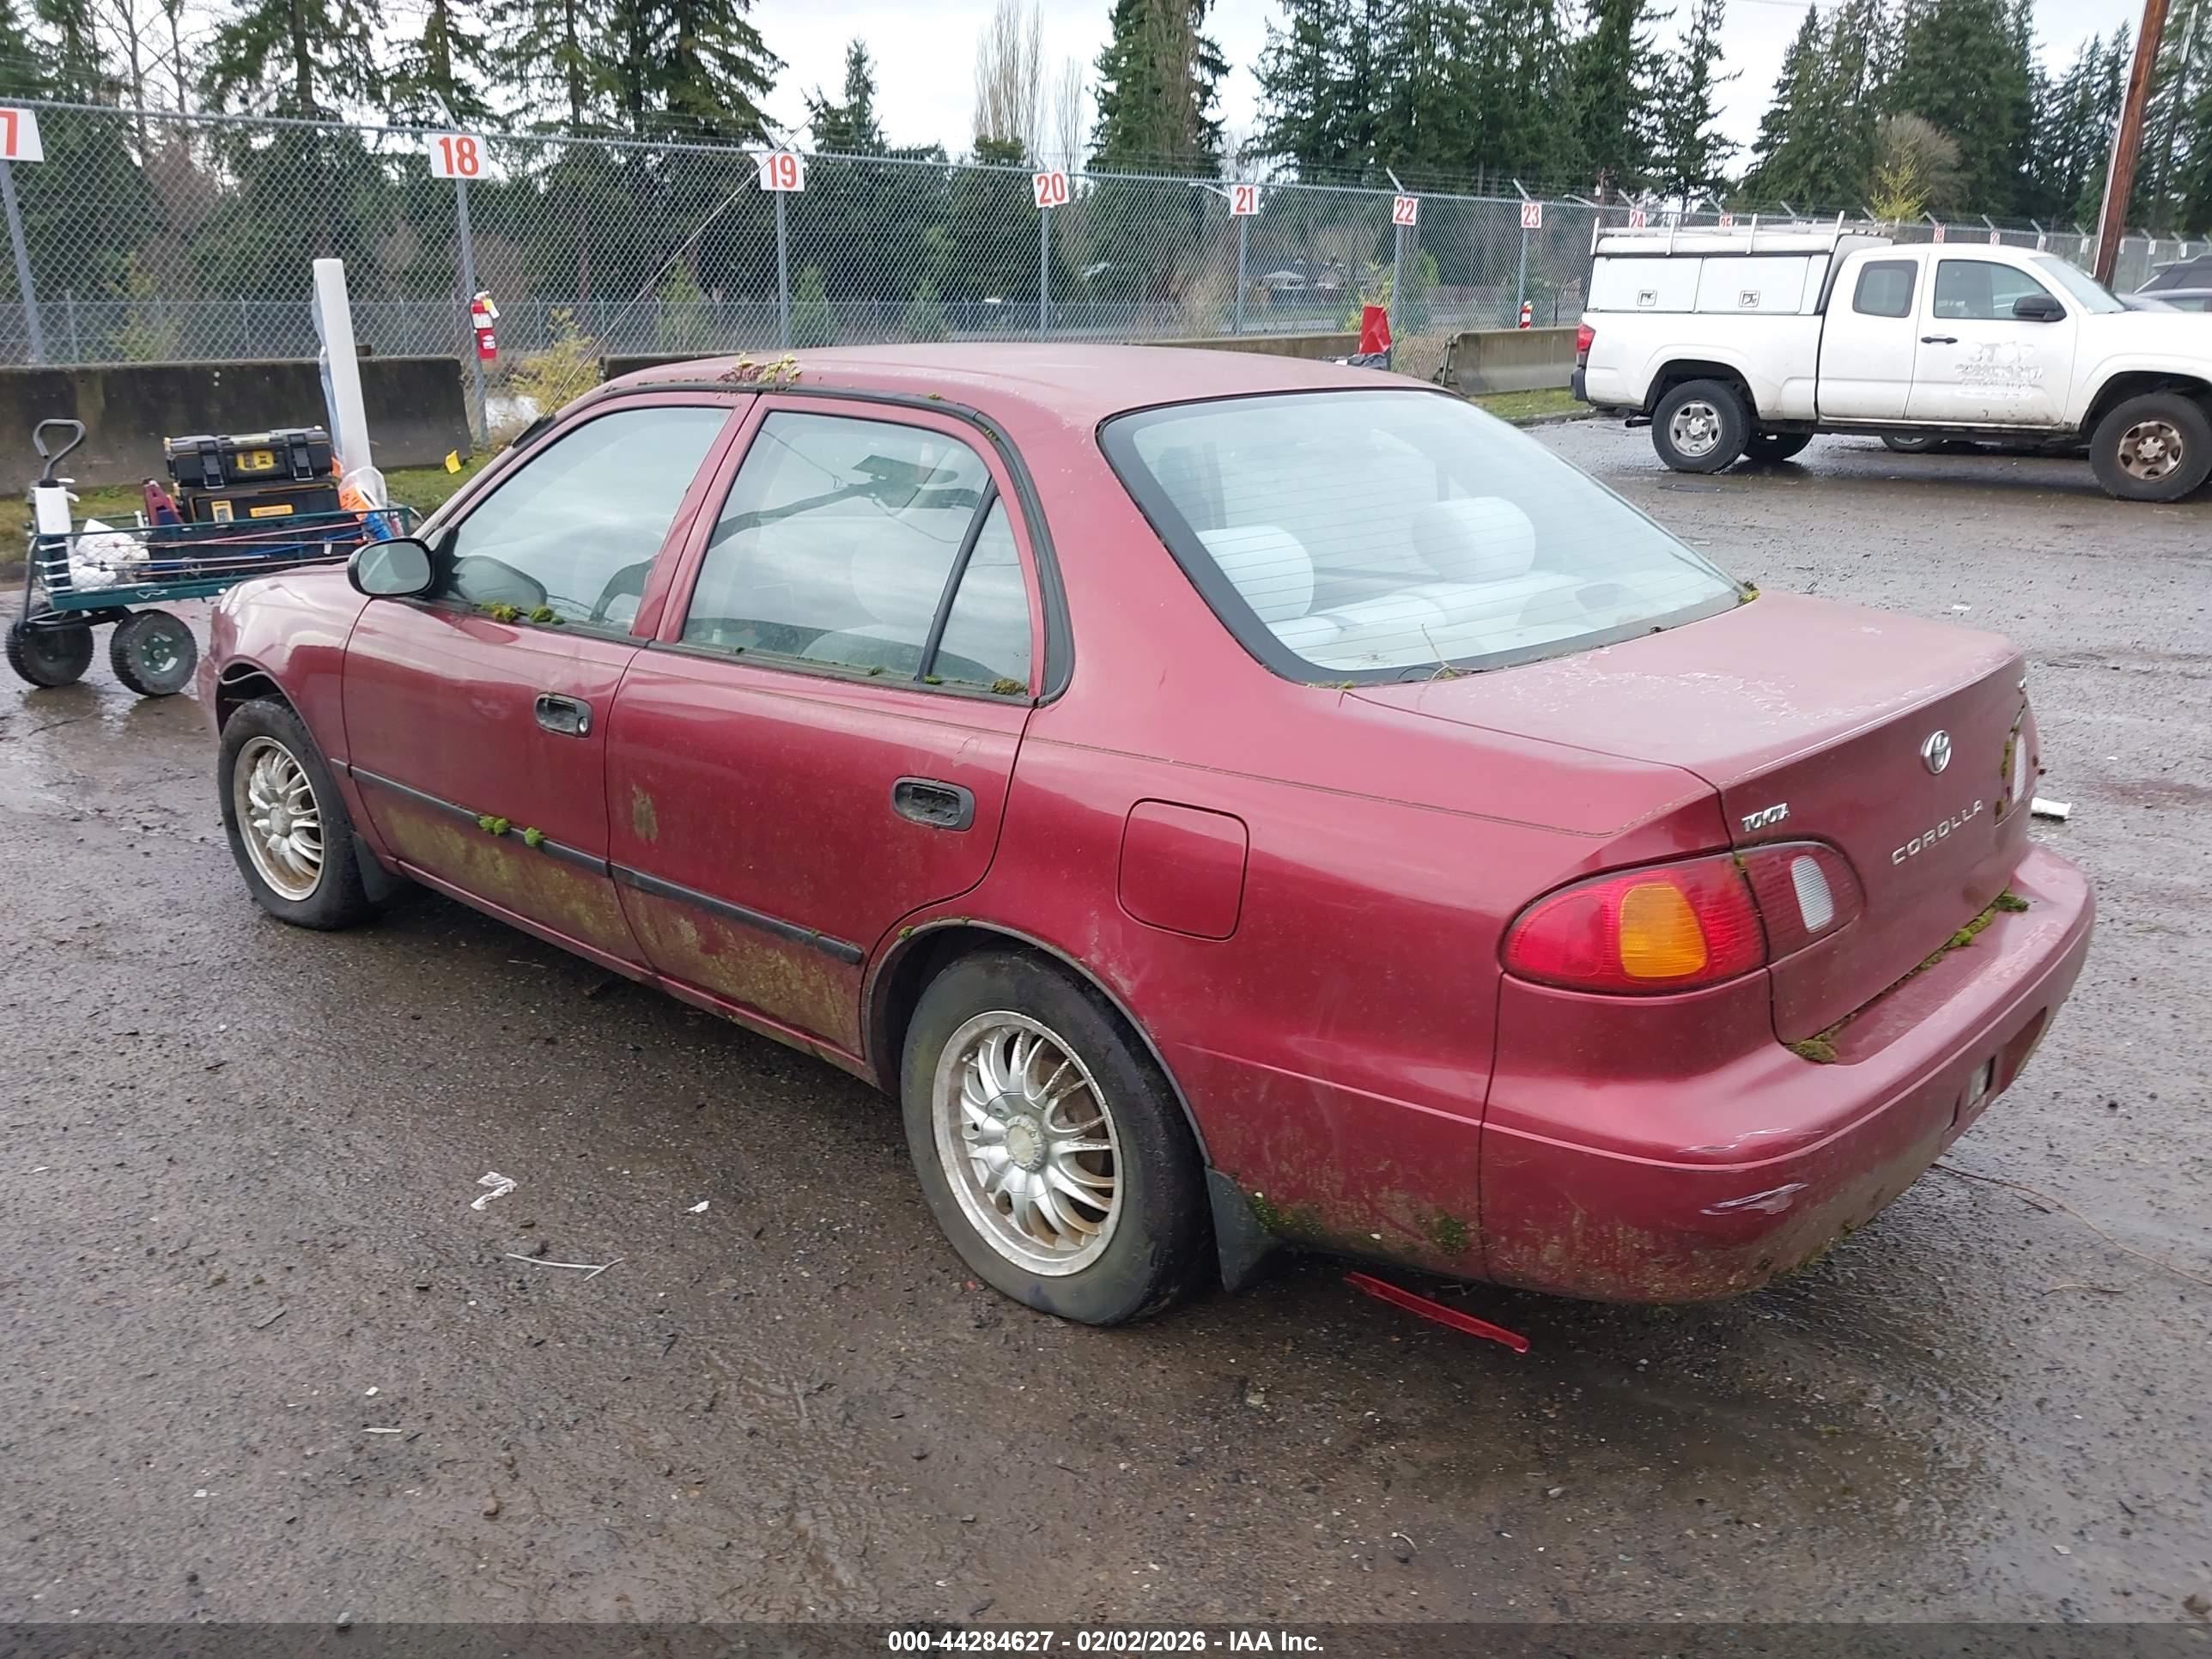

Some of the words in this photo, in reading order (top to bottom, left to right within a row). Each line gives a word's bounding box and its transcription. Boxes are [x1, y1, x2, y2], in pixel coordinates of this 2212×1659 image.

[439, 137, 479, 176] 18
[769, 155, 797, 189] 19
[1036, 173, 1066, 204] 20
[1236, 186, 1254, 213] 21
[1395, 198, 1415, 223] 22
[1523, 205, 1540, 227] 23
[1891, 799, 1984, 866] COROLLA
